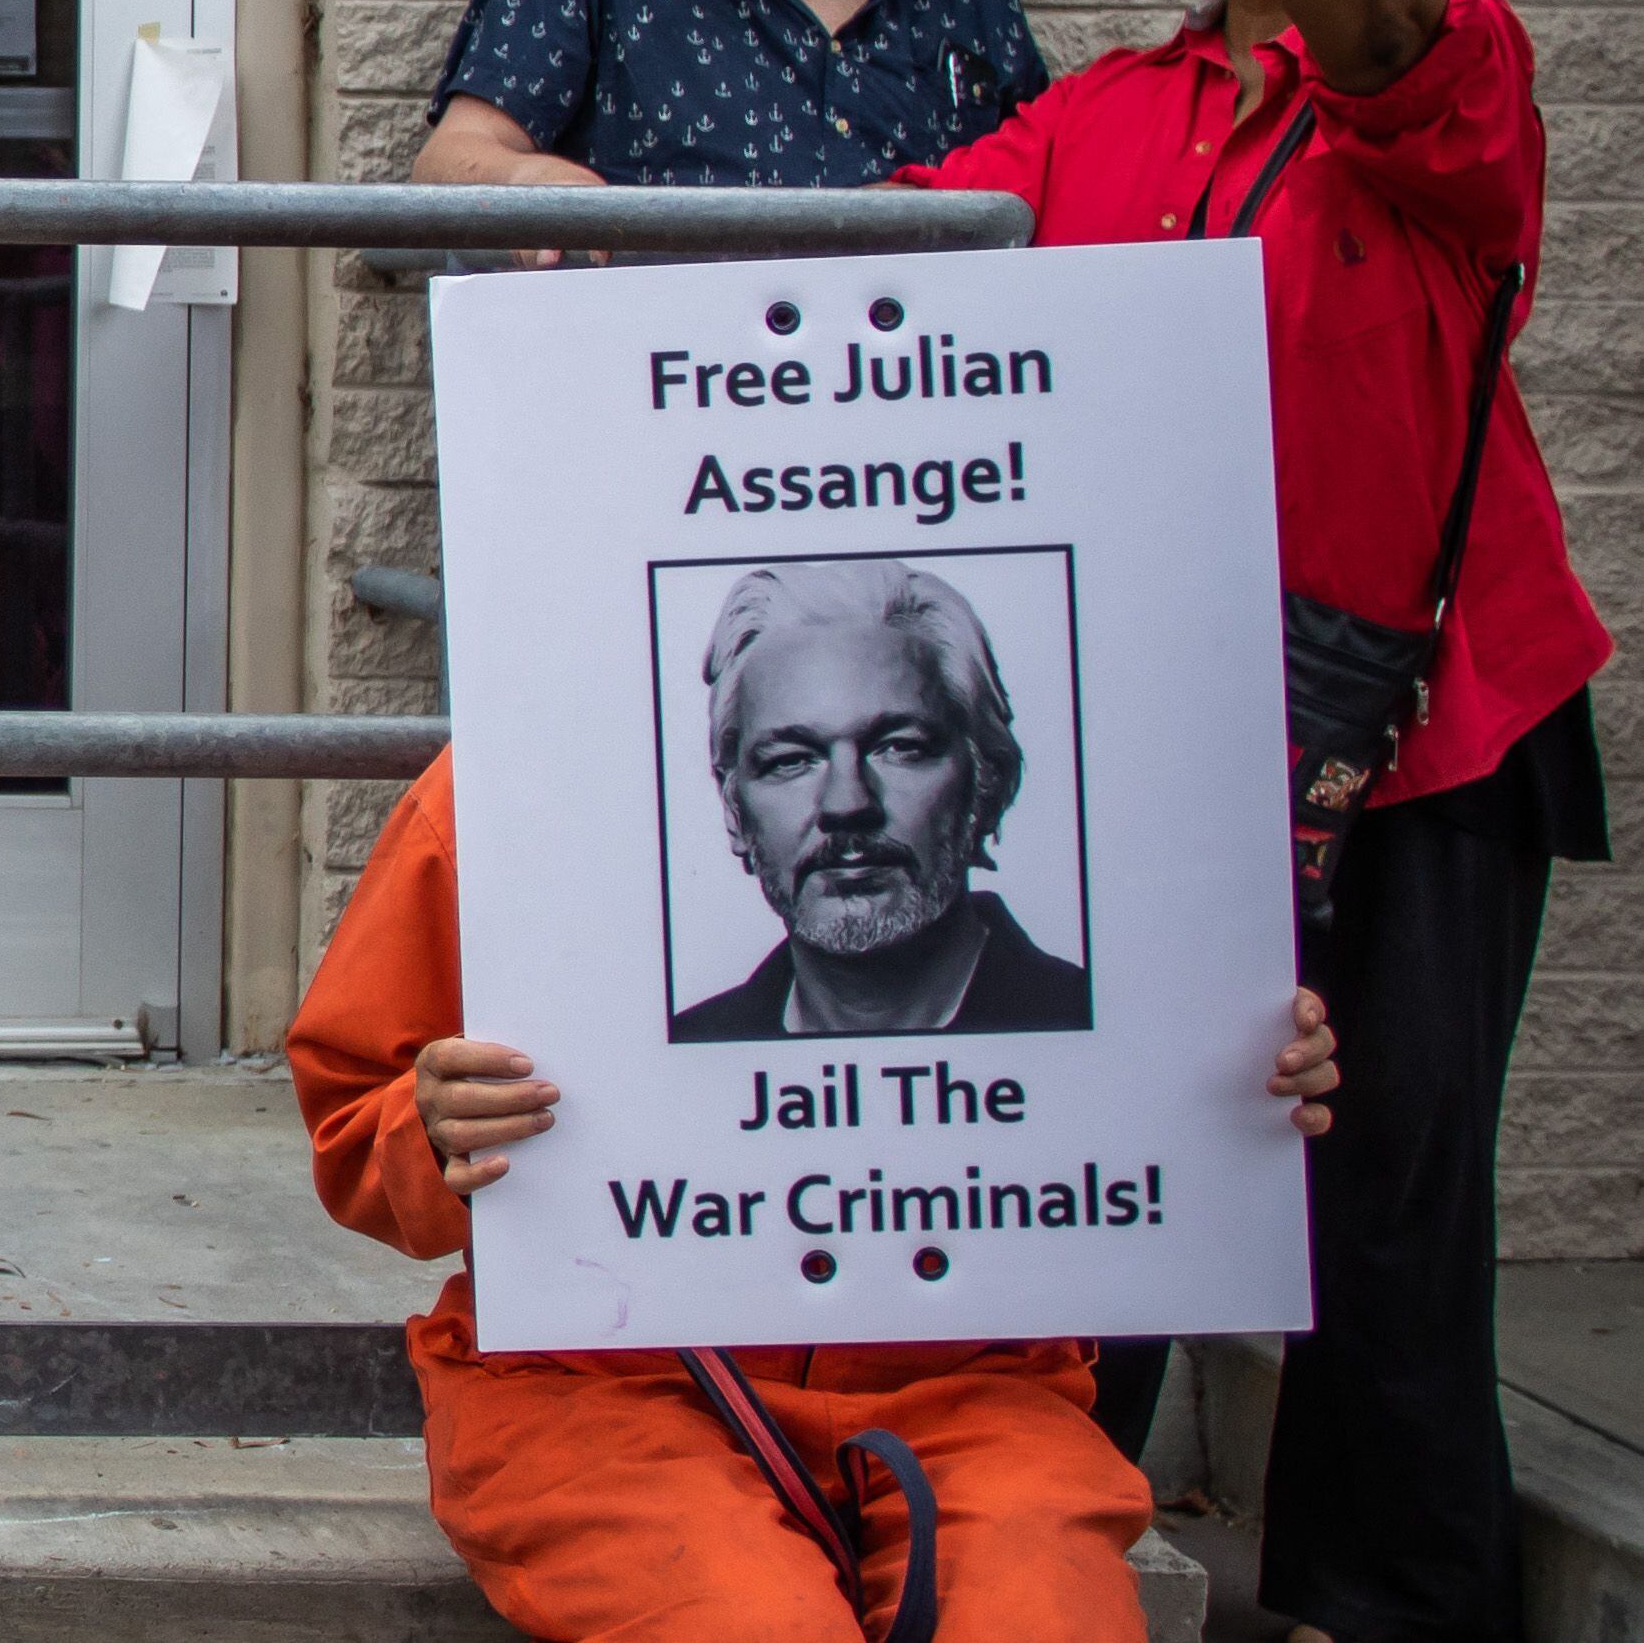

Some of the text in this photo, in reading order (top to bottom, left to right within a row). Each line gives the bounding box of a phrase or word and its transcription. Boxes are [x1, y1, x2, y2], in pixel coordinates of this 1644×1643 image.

[650, 334, 1052, 410] Free Julian
[684, 441, 1026, 525] Assange!
[740, 1060, 1025, 1131] Jail The
[608, 1162, 1163, 1239] War Criminals!
